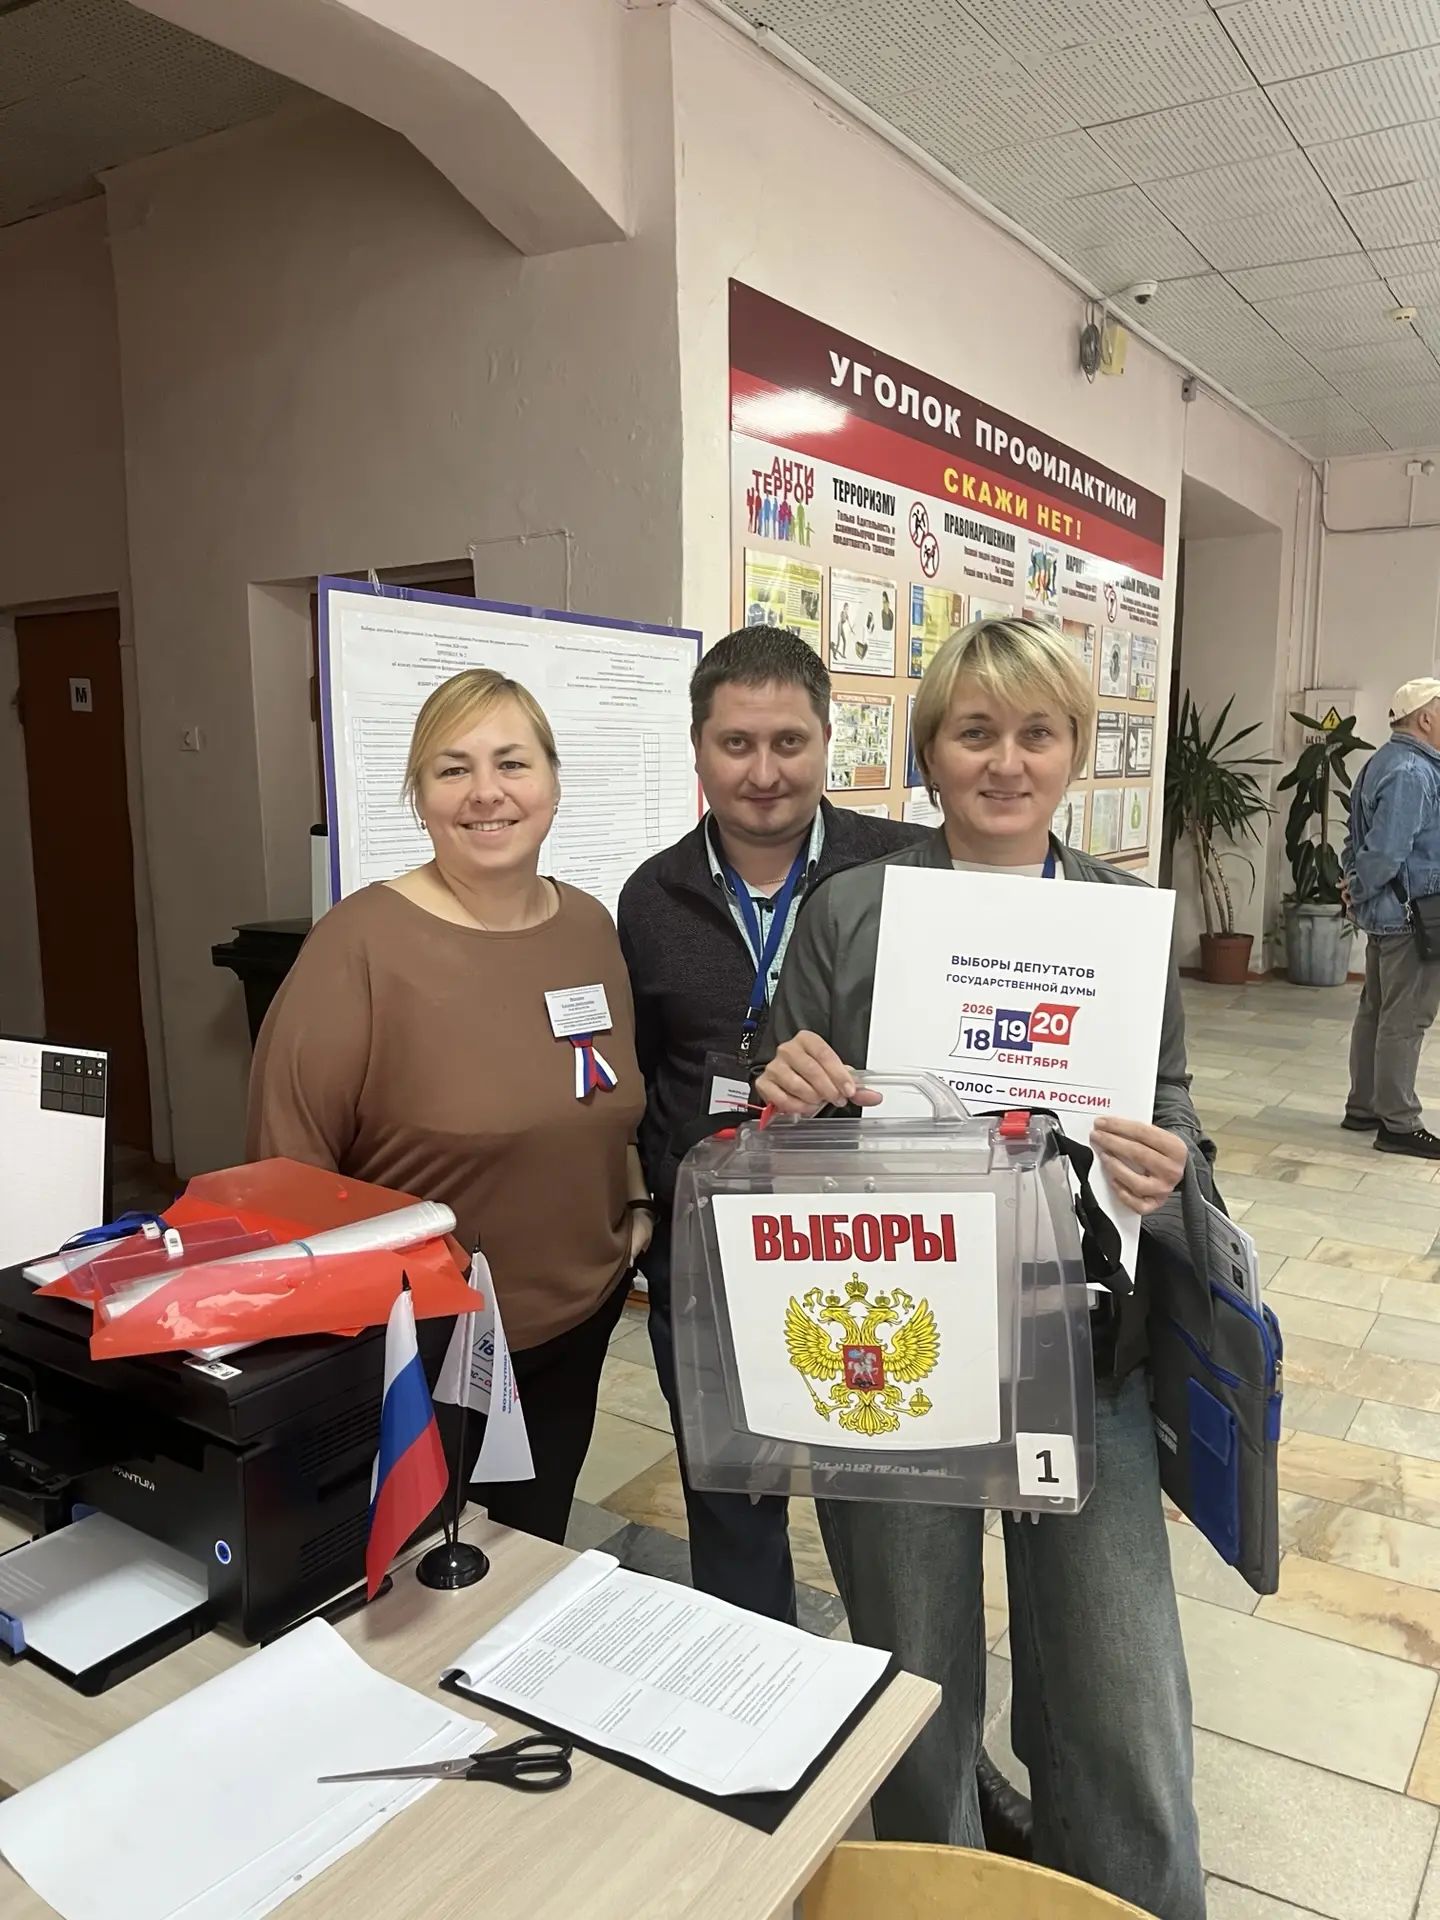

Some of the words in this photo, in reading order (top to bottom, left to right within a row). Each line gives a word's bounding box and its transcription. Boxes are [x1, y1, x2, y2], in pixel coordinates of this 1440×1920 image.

[829, 350, 961, 438] УГОЛОК
[976, 418, 1137, 520] ПРОФИЛАКТИКИ
[752, 469, 815, 506] ТЕРРОР
[771, 456, 815, 488] АНТИ
[832, 477, 896, 517] ТЕРРОРИЗМУ
[943, 467, 1028, 520] СКАЖИ
[1037, 503, 1082, 540] НЕТ!
[944, 512, 1016, 553] ПРАВОНАРУШЕНИЯМ
[951, 955, 1011, 971] ВЫБОРЫ
[1013, 961, 1095, 979] ДЕПУТАТОВ
[946, 973, 1058, 993] ГОСУДАРСТВЕННОЙ
[1060, 985, 1096, 997] ДУМЫ
[961, 1003, 994, 1015] 2026
[963, 1028, 990, 1051] 18
[998, 1019, 1027, 1043] 19
[1032, 1011, 1069, 1036] 20
[997, 1053, 1069, 1070] СЕНТЯБРЯ
[949, 1079, 993, 1094] ГОЛОС
[1008, 1086, 1046, 1101] СИЛА
[1049, 1091, 1112, 1108] РОССИИ!
[751, 1212, 958, 1263] ВЫБОРЫ
[112, 1464, 156, 1492] PANTUM
[1035, 1449, 1060, 1484] 1
